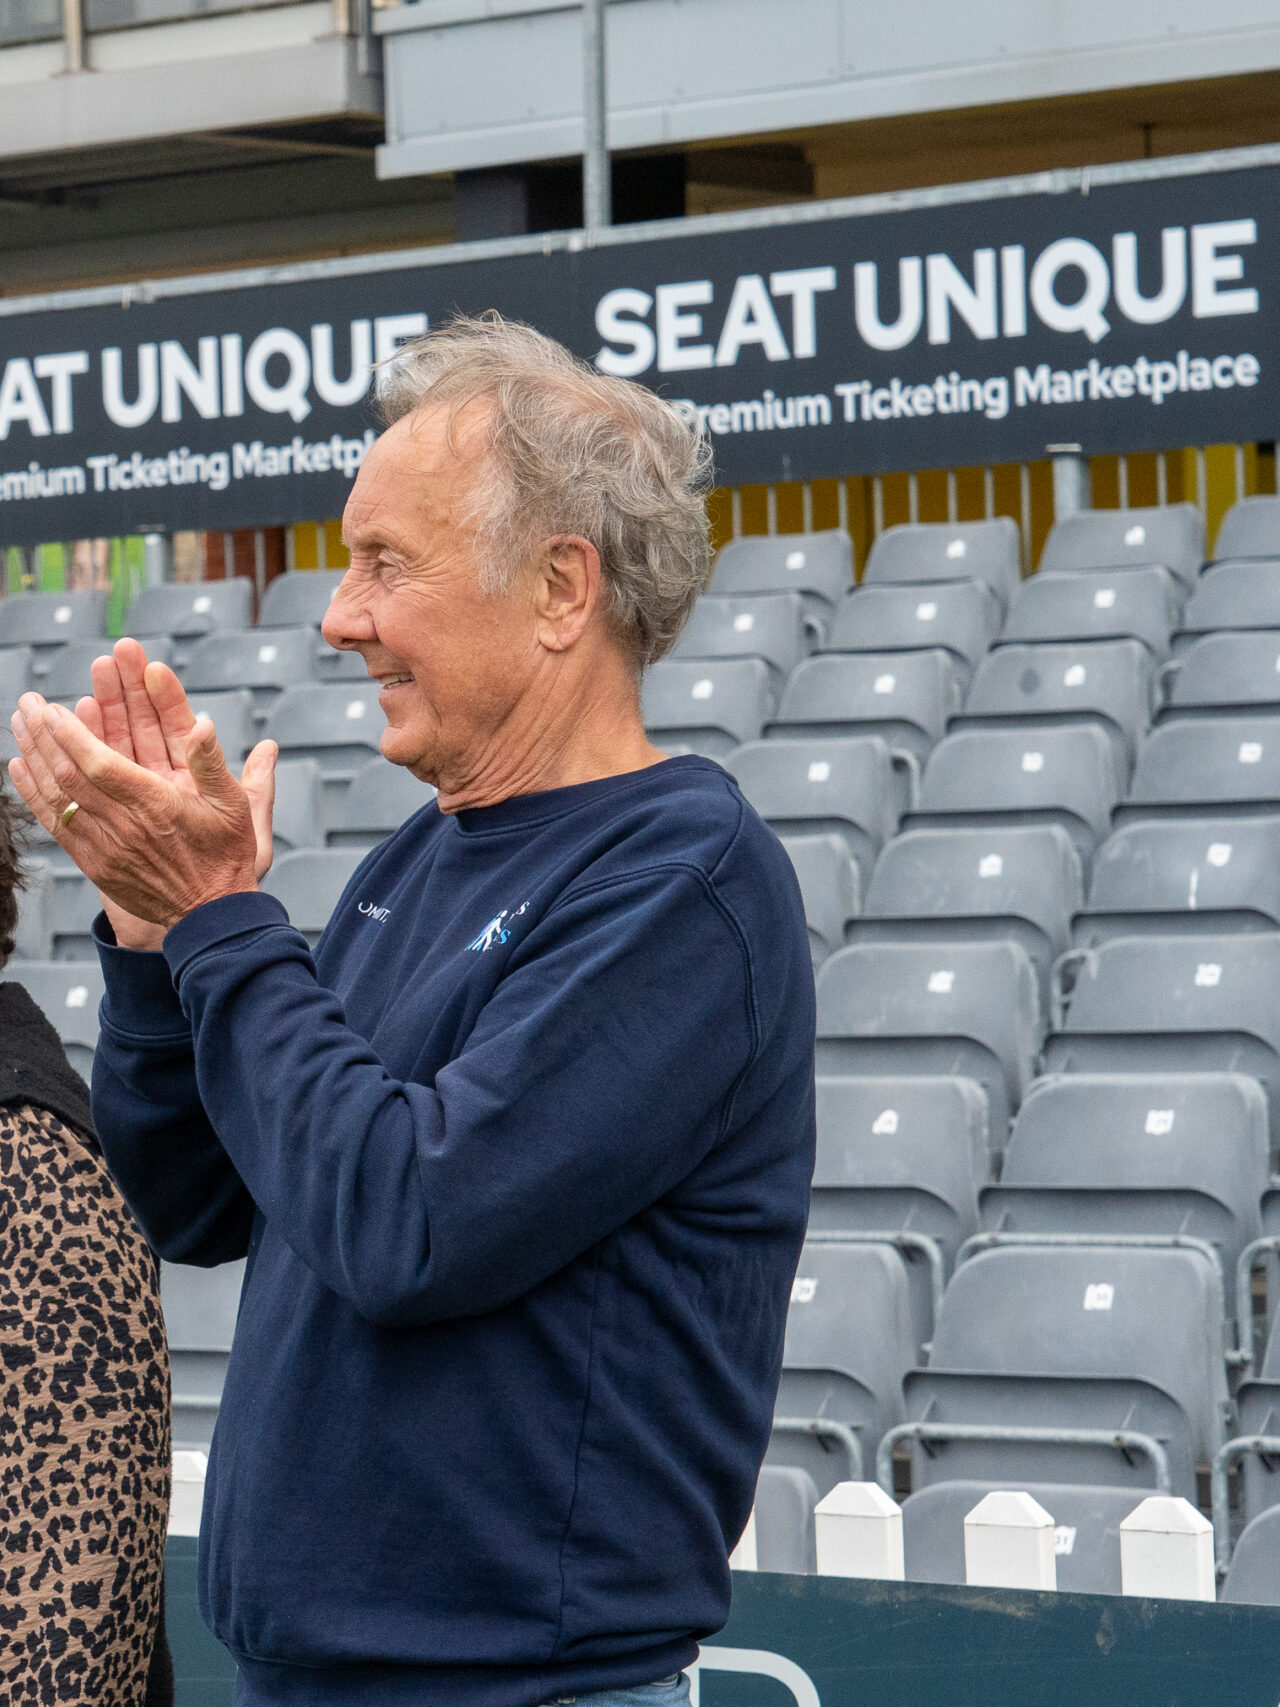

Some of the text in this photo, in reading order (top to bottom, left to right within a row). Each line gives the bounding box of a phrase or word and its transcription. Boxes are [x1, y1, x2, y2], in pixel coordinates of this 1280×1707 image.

[594, 219, 1259, 377] SEAT UNIQUE
[101, 312, 428, 423] UNIQUE
[834, 373, 1009, 424] Ticketing
[1014, 351, 1261, 411] Marketplace
[87, 447, 230, 492] Ticketing
